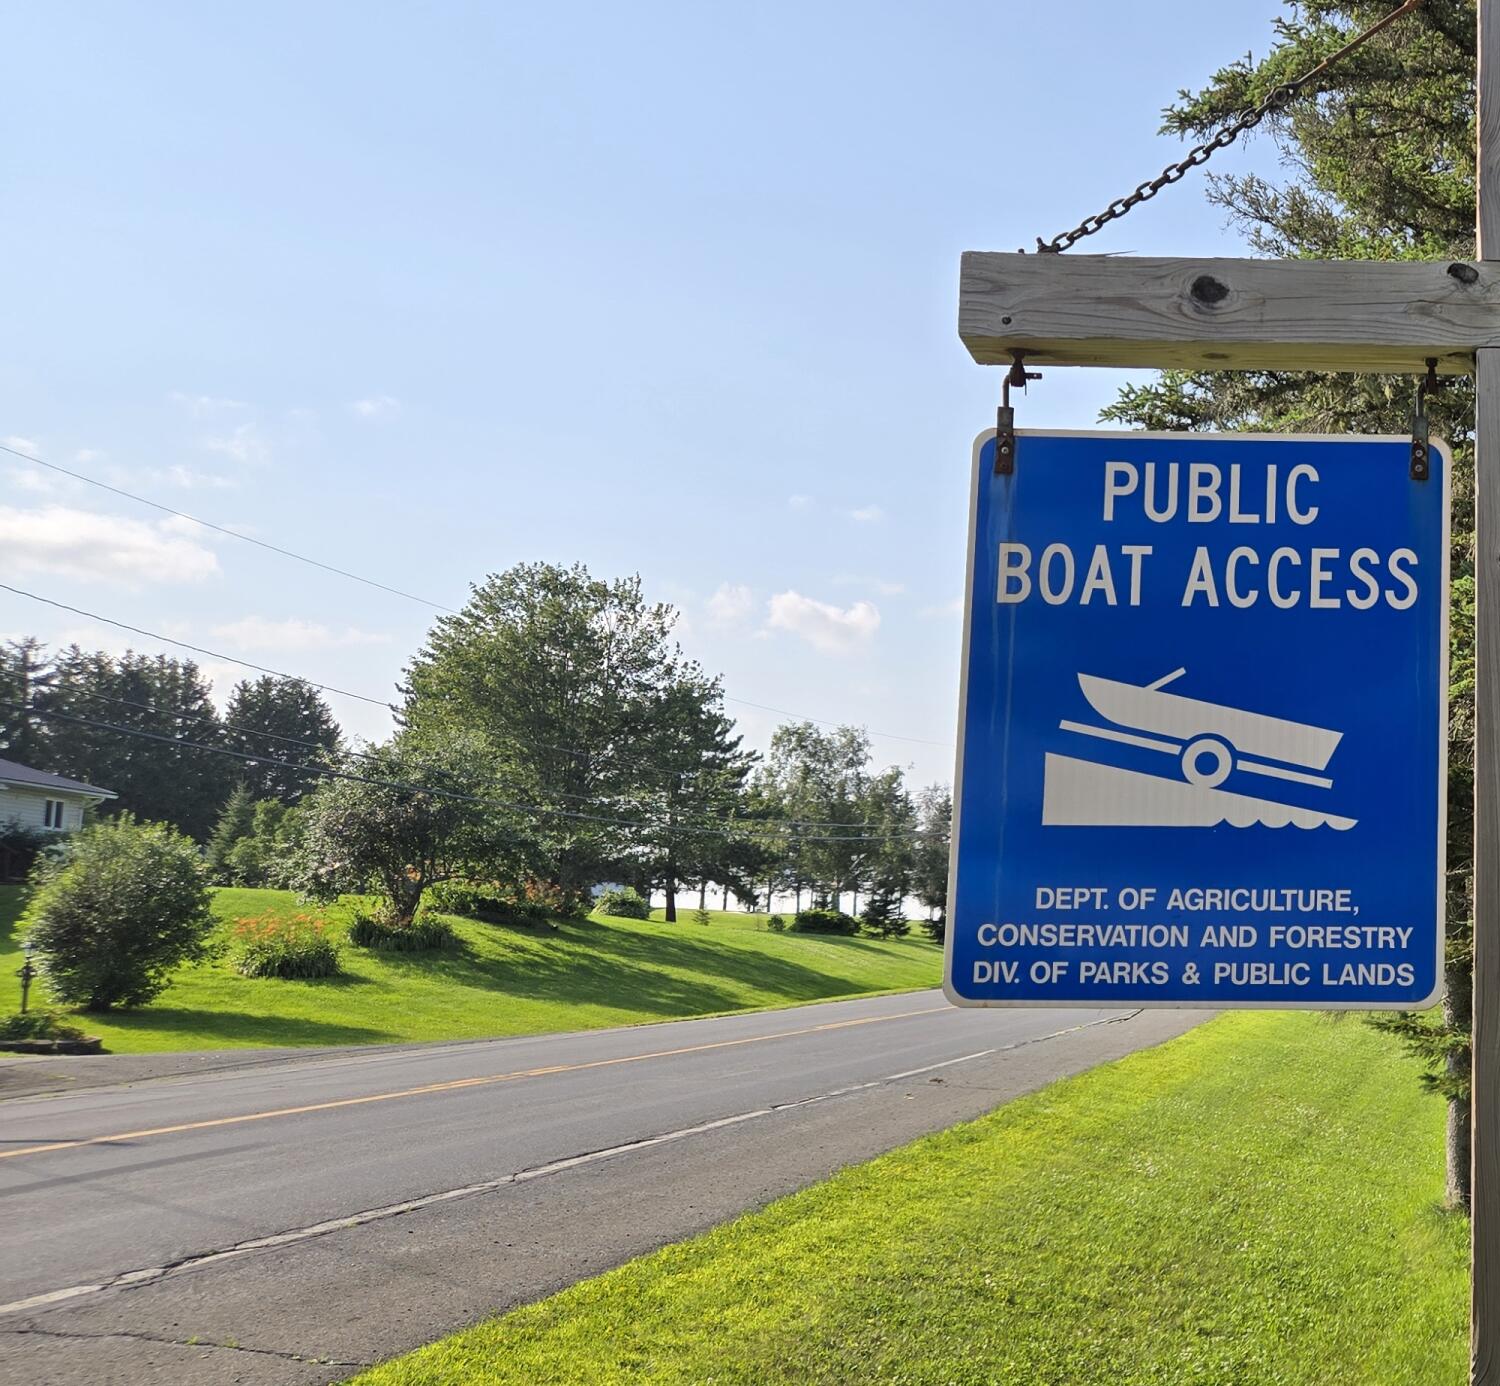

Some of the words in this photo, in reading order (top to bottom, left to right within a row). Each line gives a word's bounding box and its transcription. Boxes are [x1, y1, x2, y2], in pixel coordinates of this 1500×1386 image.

[1103, 461, 1320, 524] PUBLIC
[996, 542, 1153, 606] BOAT
[1181, 546, 1419, 610] ACCESS
[1036, 887, 1109, 910] DEPT.
[1118, 888, 1157, 911] OF
[1166, 888, 1359, 916] AGRICULTURE,
[977, 923, 1189, 948] CONSERVATION
[1200, 925, 1258, 948] AND
[1269, 925, 1414, 949] FORESTRY
[973, 961, 1020, 983] DIV.
[1030, 961, 1069, 984] OF
[1079, 961, 1169, 985] PARKS
[1182, 962, 1200, 985] &
[1214, 962, 1310, 986] PUBLIC
[1322, 963, 1415, 987] LANDS
